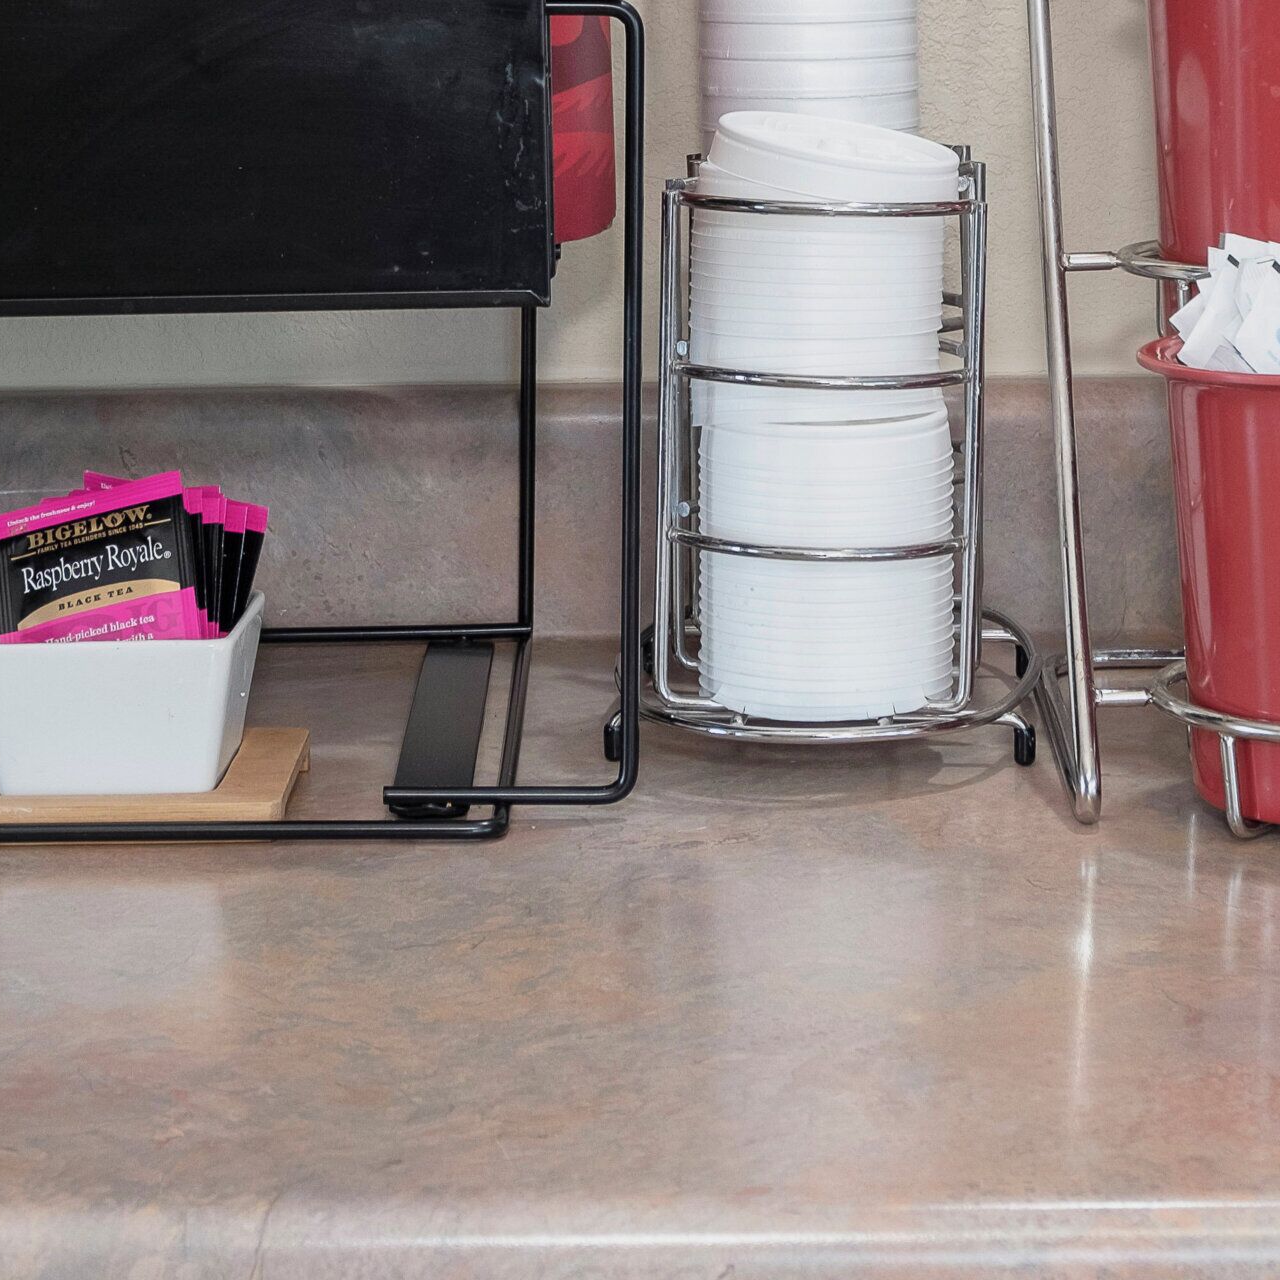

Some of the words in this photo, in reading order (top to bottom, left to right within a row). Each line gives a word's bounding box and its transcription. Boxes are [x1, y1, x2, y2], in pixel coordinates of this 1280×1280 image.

[26, 505, 150, 550] BIGELOW
[21, 553, 104, 595] Raspberry
[58, 594, 102, 611] BLACK
[106, 586, 135, 599] TEA
[109, 617, 138, 632] black
[139, 615, 155, 624] tea
